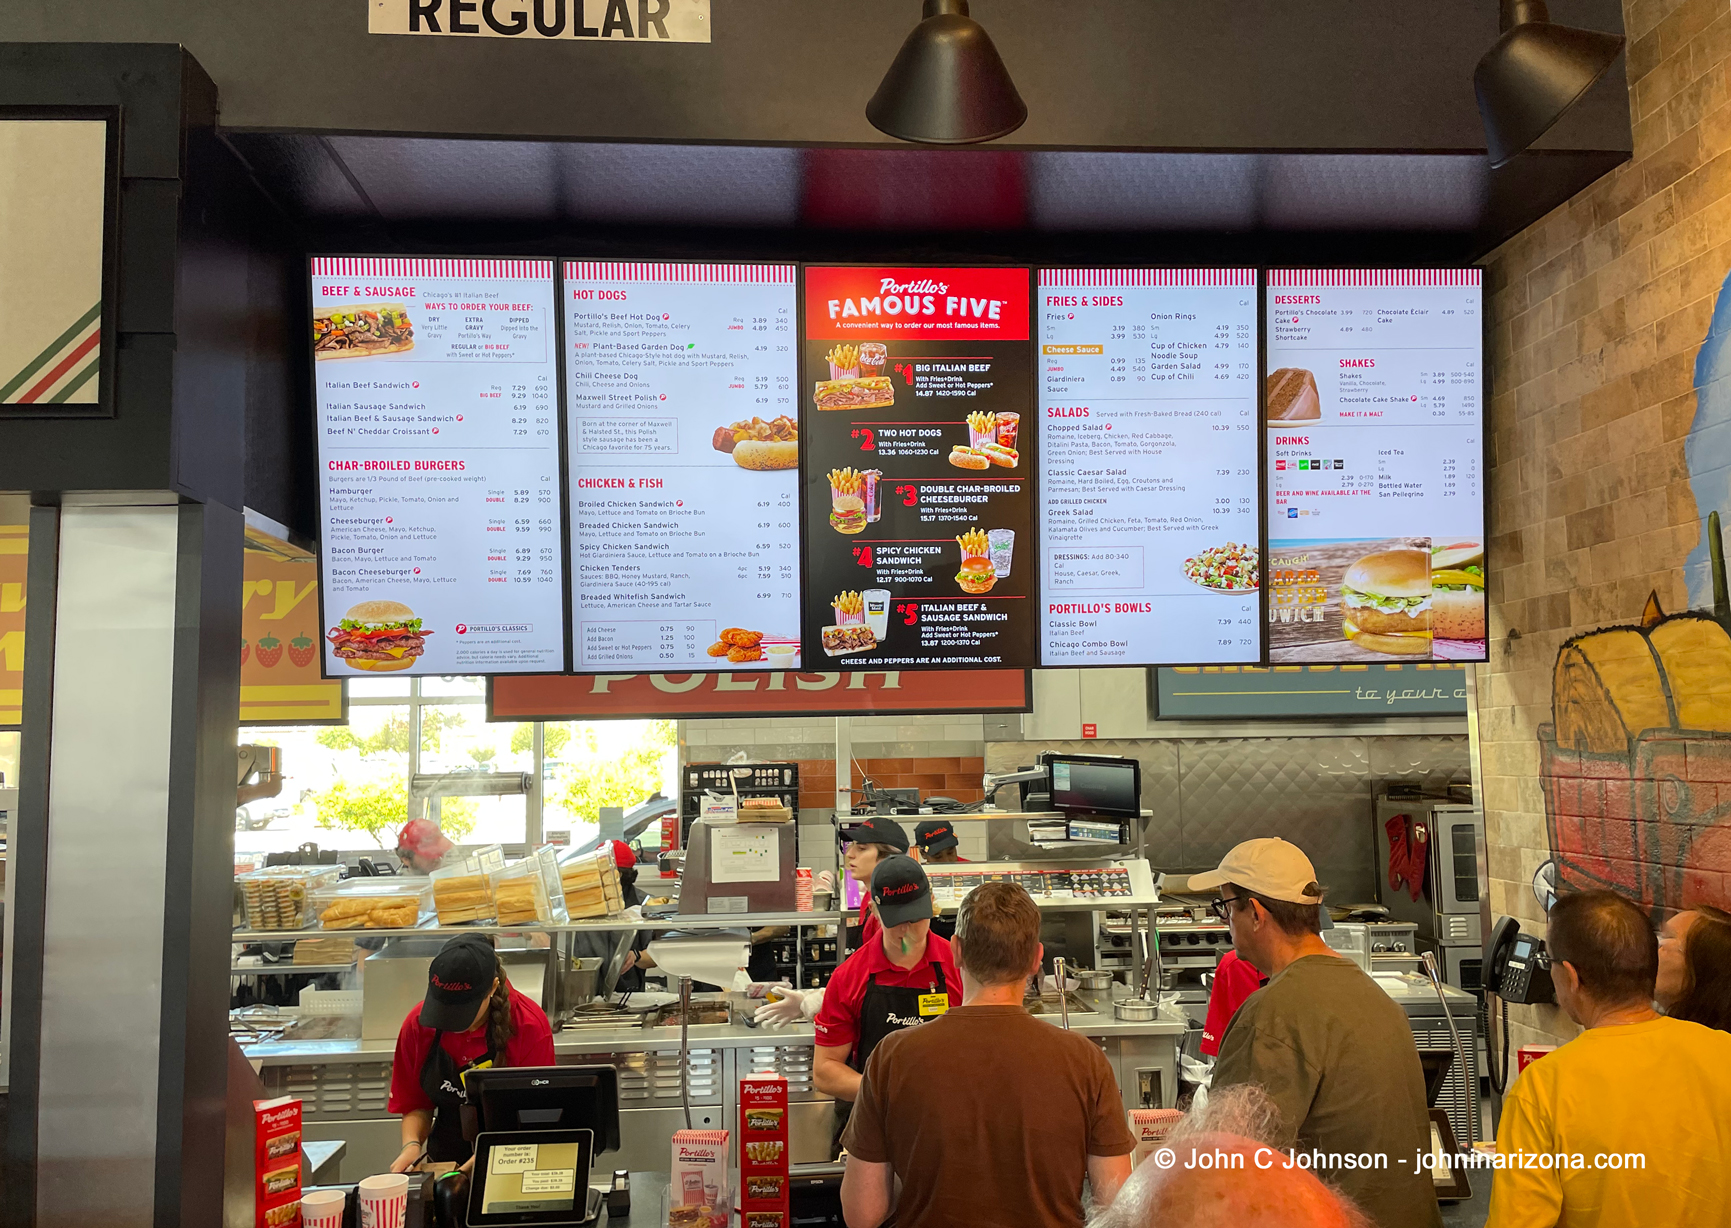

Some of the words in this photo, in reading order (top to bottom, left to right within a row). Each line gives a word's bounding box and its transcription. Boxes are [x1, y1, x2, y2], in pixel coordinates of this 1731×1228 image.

[409, 0, 670, 39] REGULAR
[322, 286, 350, 296] BEEF
[354, 286, 361, 296] &
[365, 286, 416, 297] SAUSAGE
[880, 278, 949, 295] Portillo's
[573, 290, 594, 300] HOT
[598, 290, 627, 301] DOGS
[1275, 295, 1320, 304] DESSERTS
[1046, 296, 1077, 306] FRIES
[1081, 296, 1088, 306] &
[1092, 296, 1123, 306] SIDES
[448, 302, 458, 310] TO
[460, 303, 486, 311] ORDER
[828, 296, 935, 319] FAMOUS
[646, 314, 660, 322] Dog
[1175, 312, 1196, 321] Rings
[670, 344, 684, 352] Dog
[1339, 359, 1375, 368] SHAKES
[894, 363, 914, 385] #1
[1047, 407, 1090, 418] SALADS
[918, 429, 942, 437] DOGS
[1047, 424, 1080, 432] Chopped
[851, 428, 876, 450] #2
[1276, 436, 1310, 445] DRINKS
[328, 460, 411, 471] CHAR-BROILED
[414, 460, 465, 470] BURGERS
[578, 478, 625, 488] CHICKEN
[628, 478, 635, 488] &
[639, 478, 663, 488] FISH
[956, 485, 1021, 493] CHAR-BROILED
[895, 485, 918, 506] #3
[920, 495, 988, 503] CHEESEBURGER
[330, 517, 384, 525] Cheeseburger
[876, 547, 902, 555] SPICY
[852, 547, 873, 568] #4
[876, 556, 922, 565] SANDWICH
[957, 603, 979, 611] BEEF
[1049, 603, 1111, 614] PORTILLO'S
[1115, 602, 1152, 613] BOWLS
[897, 603, 918, 625] #5
[921, 614, 961, 622] SAUSAGE
[963, 613, 1008, 621] SANDWICH
[1049, 641, 1080, 649] Chicago
[1356, 686, 1381, 700] to
[1386, 687, 1449, 705] your
[925, 827, 947, 839] Portillo's
[883, 883, 919, 896] Portillo's
[431, 974, 472, 991] Portillo's
[886, 1013, 924, 1026] Portillo's
[744, 1084, 782, 1094] Portillo's
[262, 1107, 298, 1124] Portillo's
[679, 1148, 715, 1157] Portillo's
